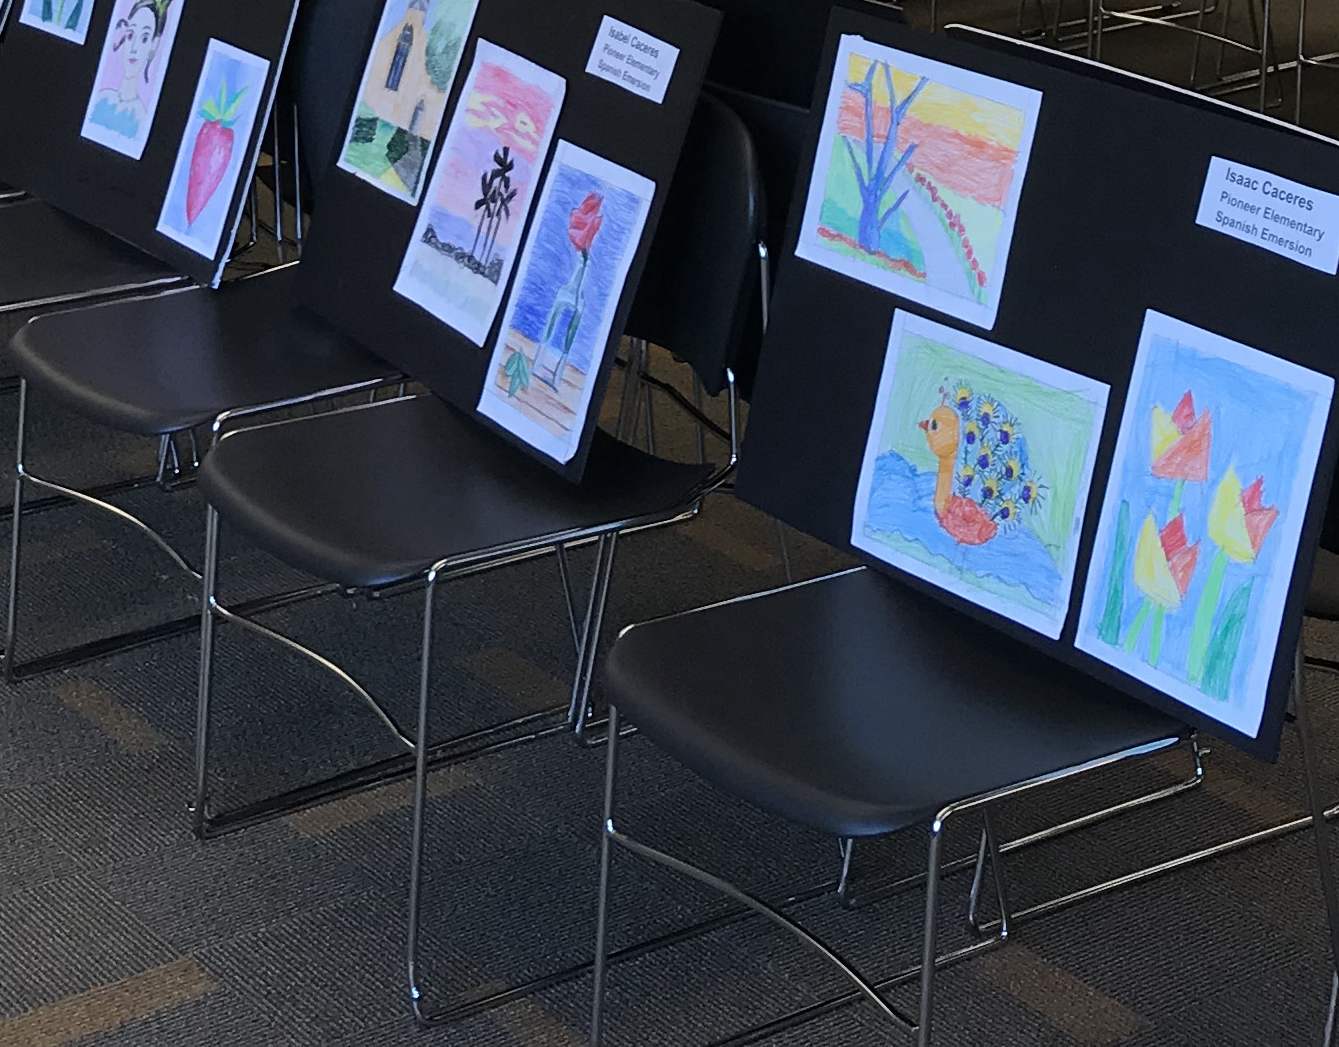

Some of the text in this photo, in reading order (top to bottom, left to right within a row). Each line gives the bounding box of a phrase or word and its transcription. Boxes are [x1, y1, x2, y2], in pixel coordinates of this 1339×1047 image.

[603, 44, 661, 81] Pioneer Elementary
[609, 26, 660, 59] Isabel Caceres
[598, 59, 652, 92] Spanish Emersion
[1225, 167, 1314, 212] Isaac Caceres
[1215, 210, 1313, 258] Spanish Emersion
[1219, 191, 1326, 242] Pioneer Elementary
